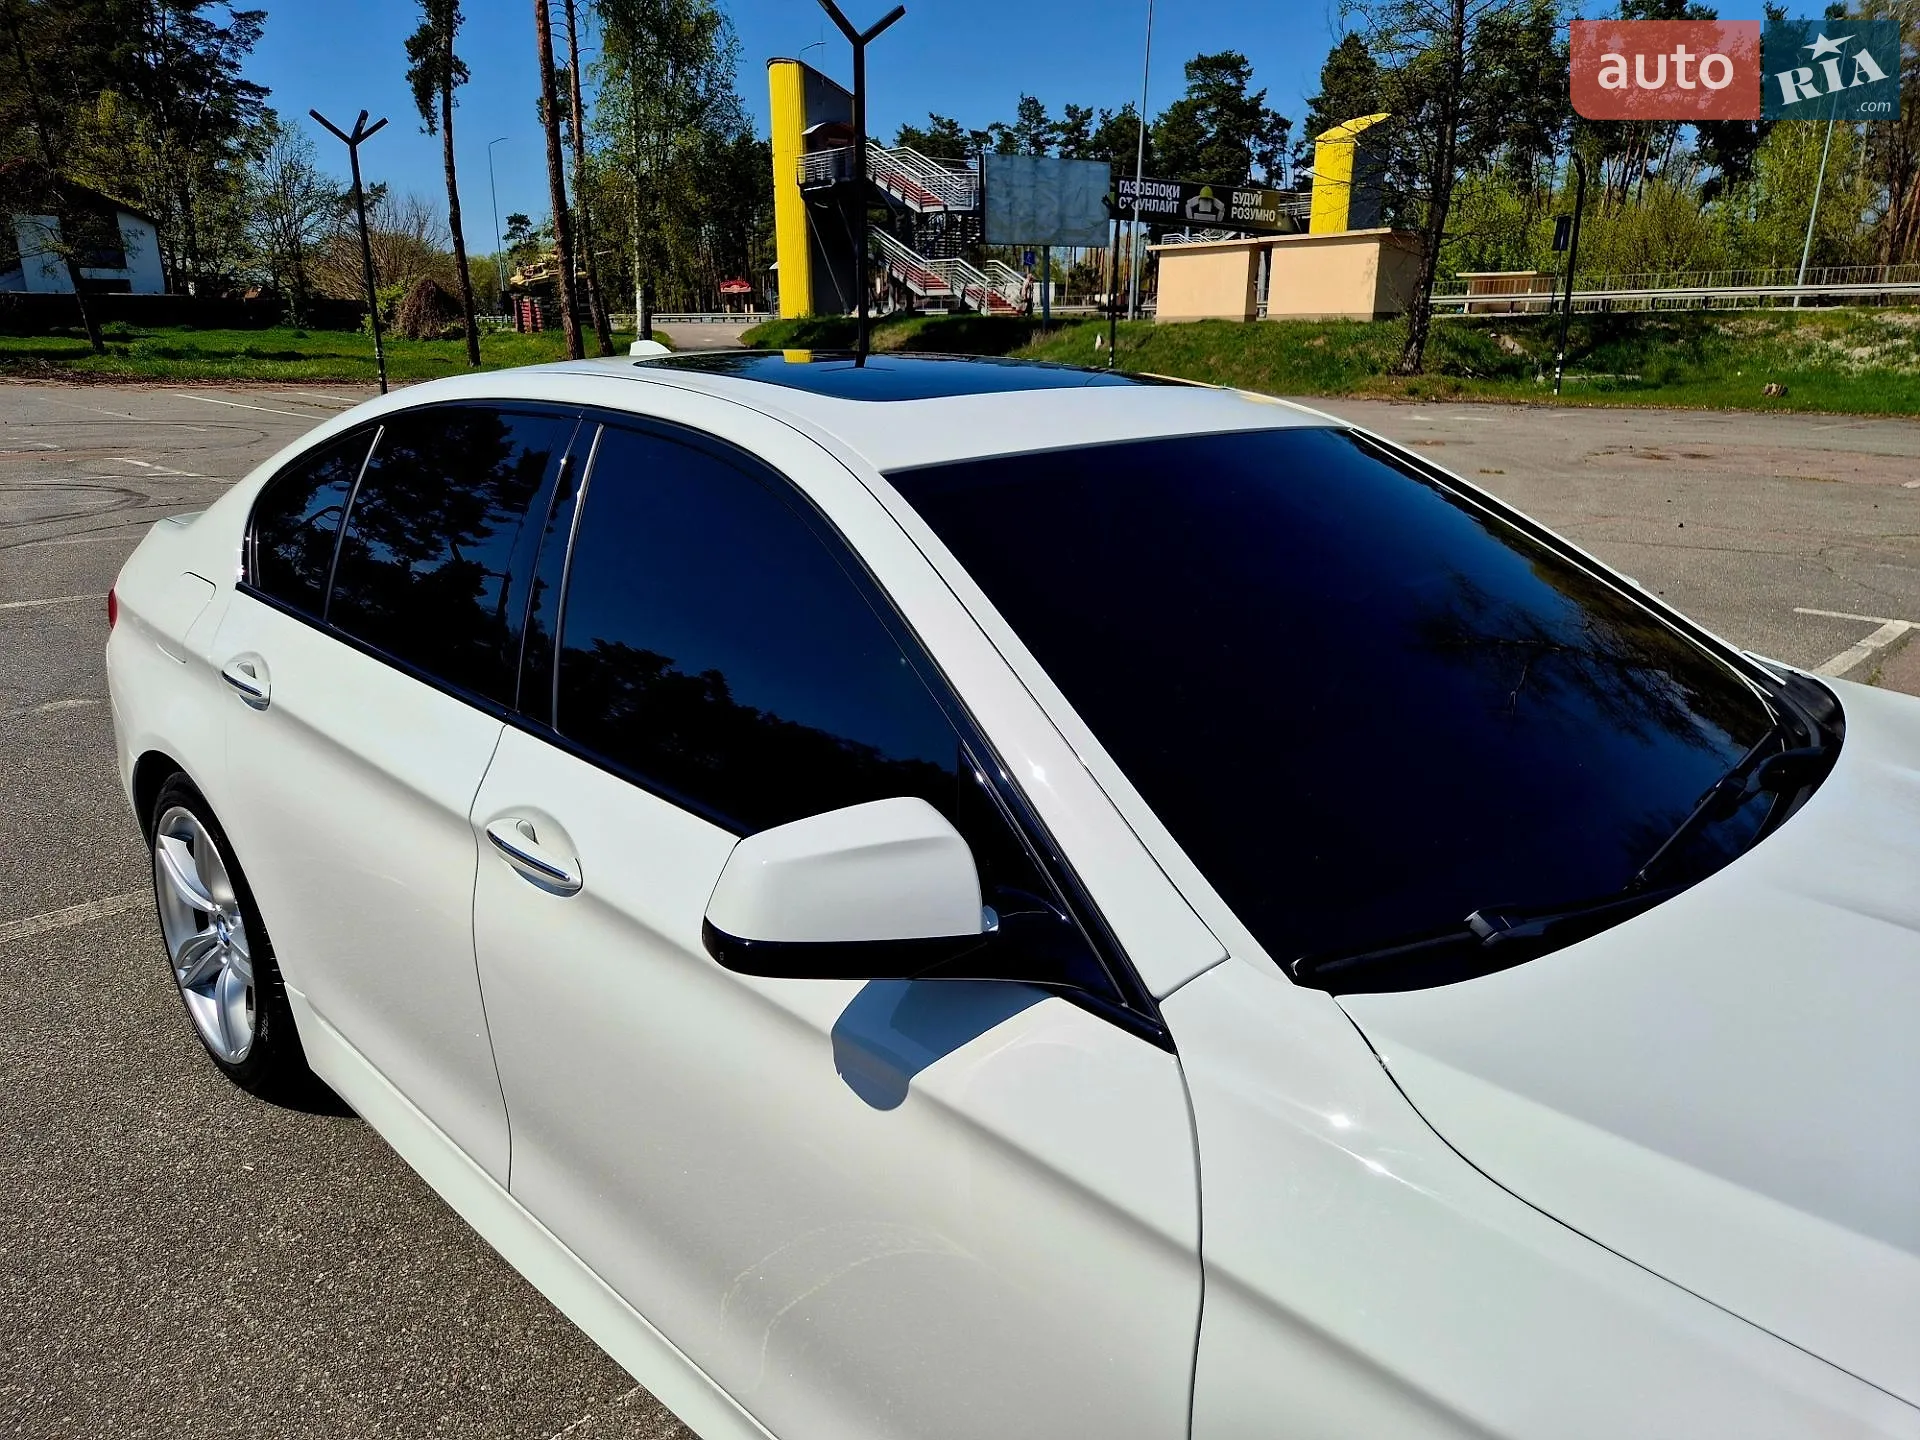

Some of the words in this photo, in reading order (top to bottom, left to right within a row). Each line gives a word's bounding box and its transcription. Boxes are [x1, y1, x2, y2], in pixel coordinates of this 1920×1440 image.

[1119, 180, 1181, 198] ГАЗОБЛОКИ
[1232, 191, 1263, 207] БУДУЙ
[1231, 206, 1276, 222] РОЗУМНО
